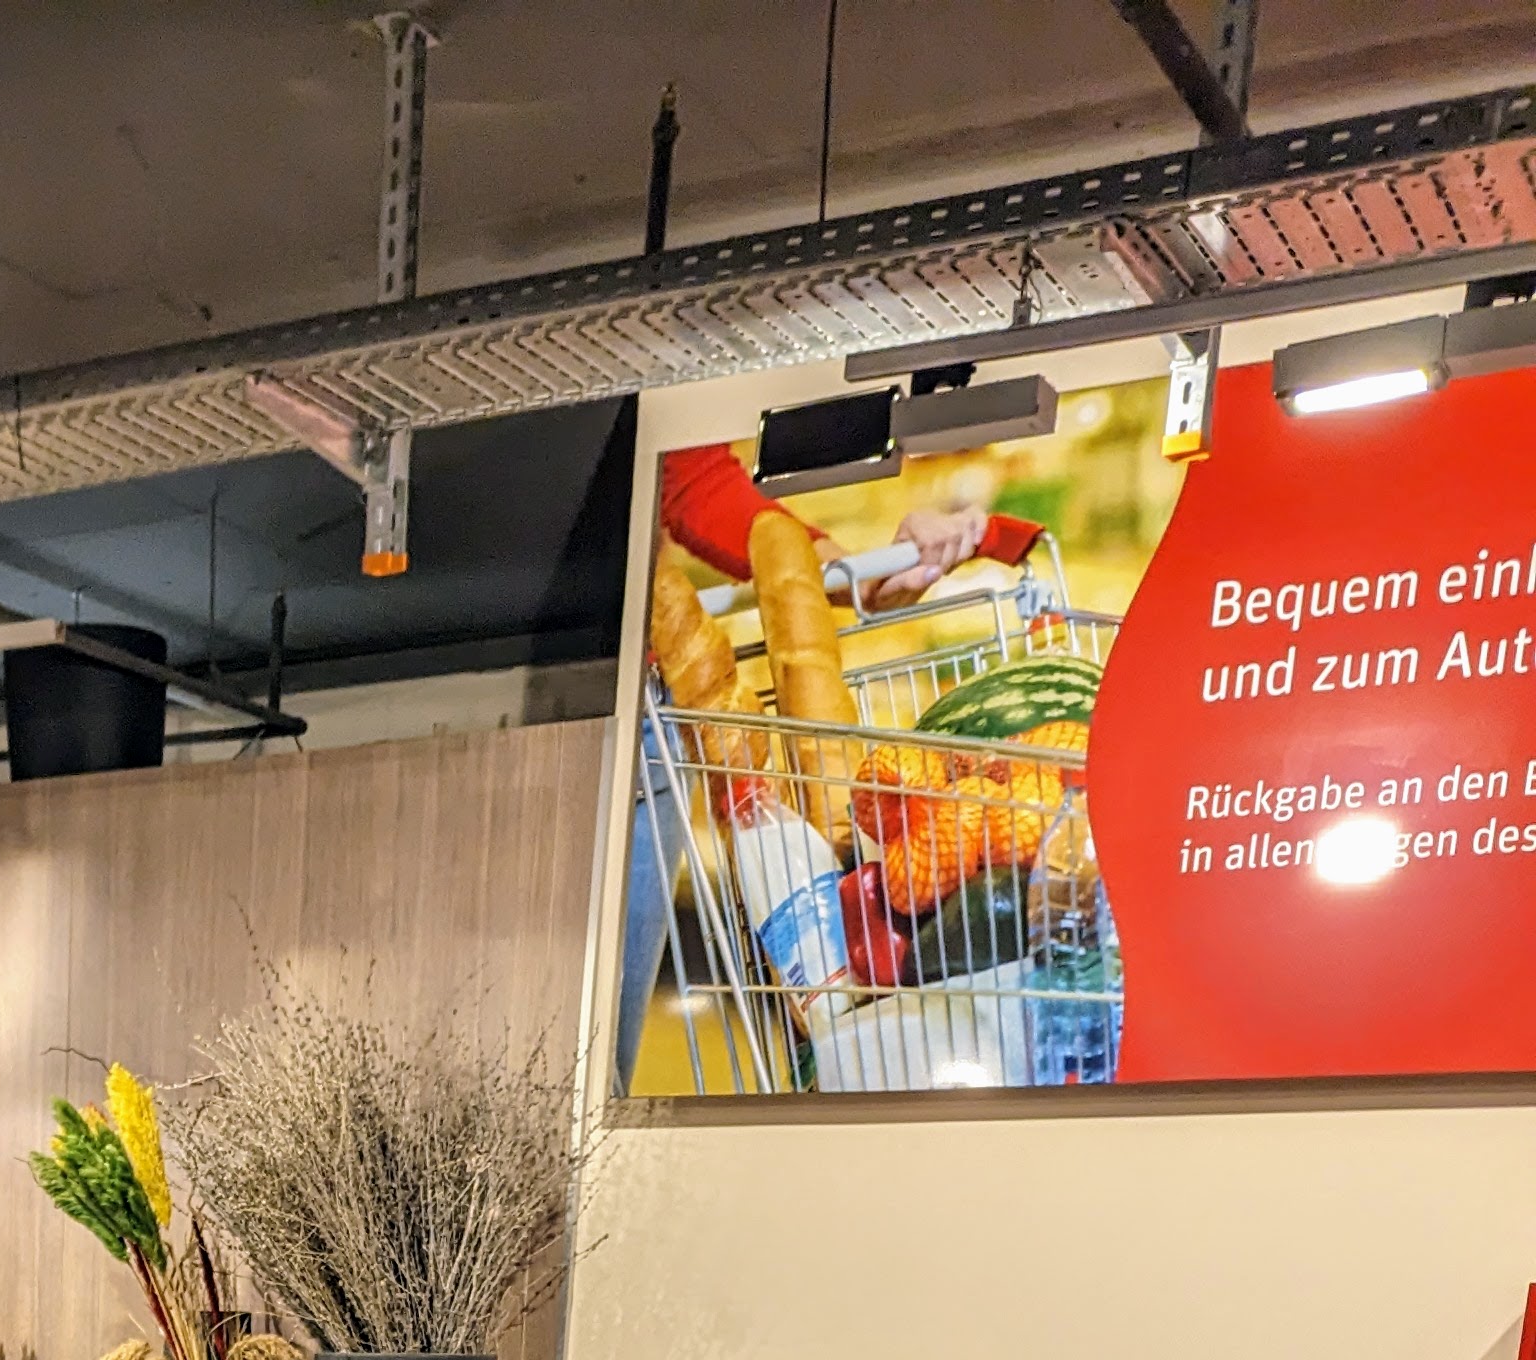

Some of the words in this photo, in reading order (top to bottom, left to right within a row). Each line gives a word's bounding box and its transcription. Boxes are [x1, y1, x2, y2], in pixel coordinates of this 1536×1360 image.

[1210, 568, 1419, 632] Bequem
[1202, 646, 1296, 703] und
[1311, 645, 1419, 692] zum
[1186, 774, 1365, 822] Rückgabe
[1377, 776, 1423, 806] an
[1437, 763, 1508, 803] den
[1180, 839, 1212, 874] in
[1225, 833, 1316, 870] allen
[1472, 817, 1536, 855] des
